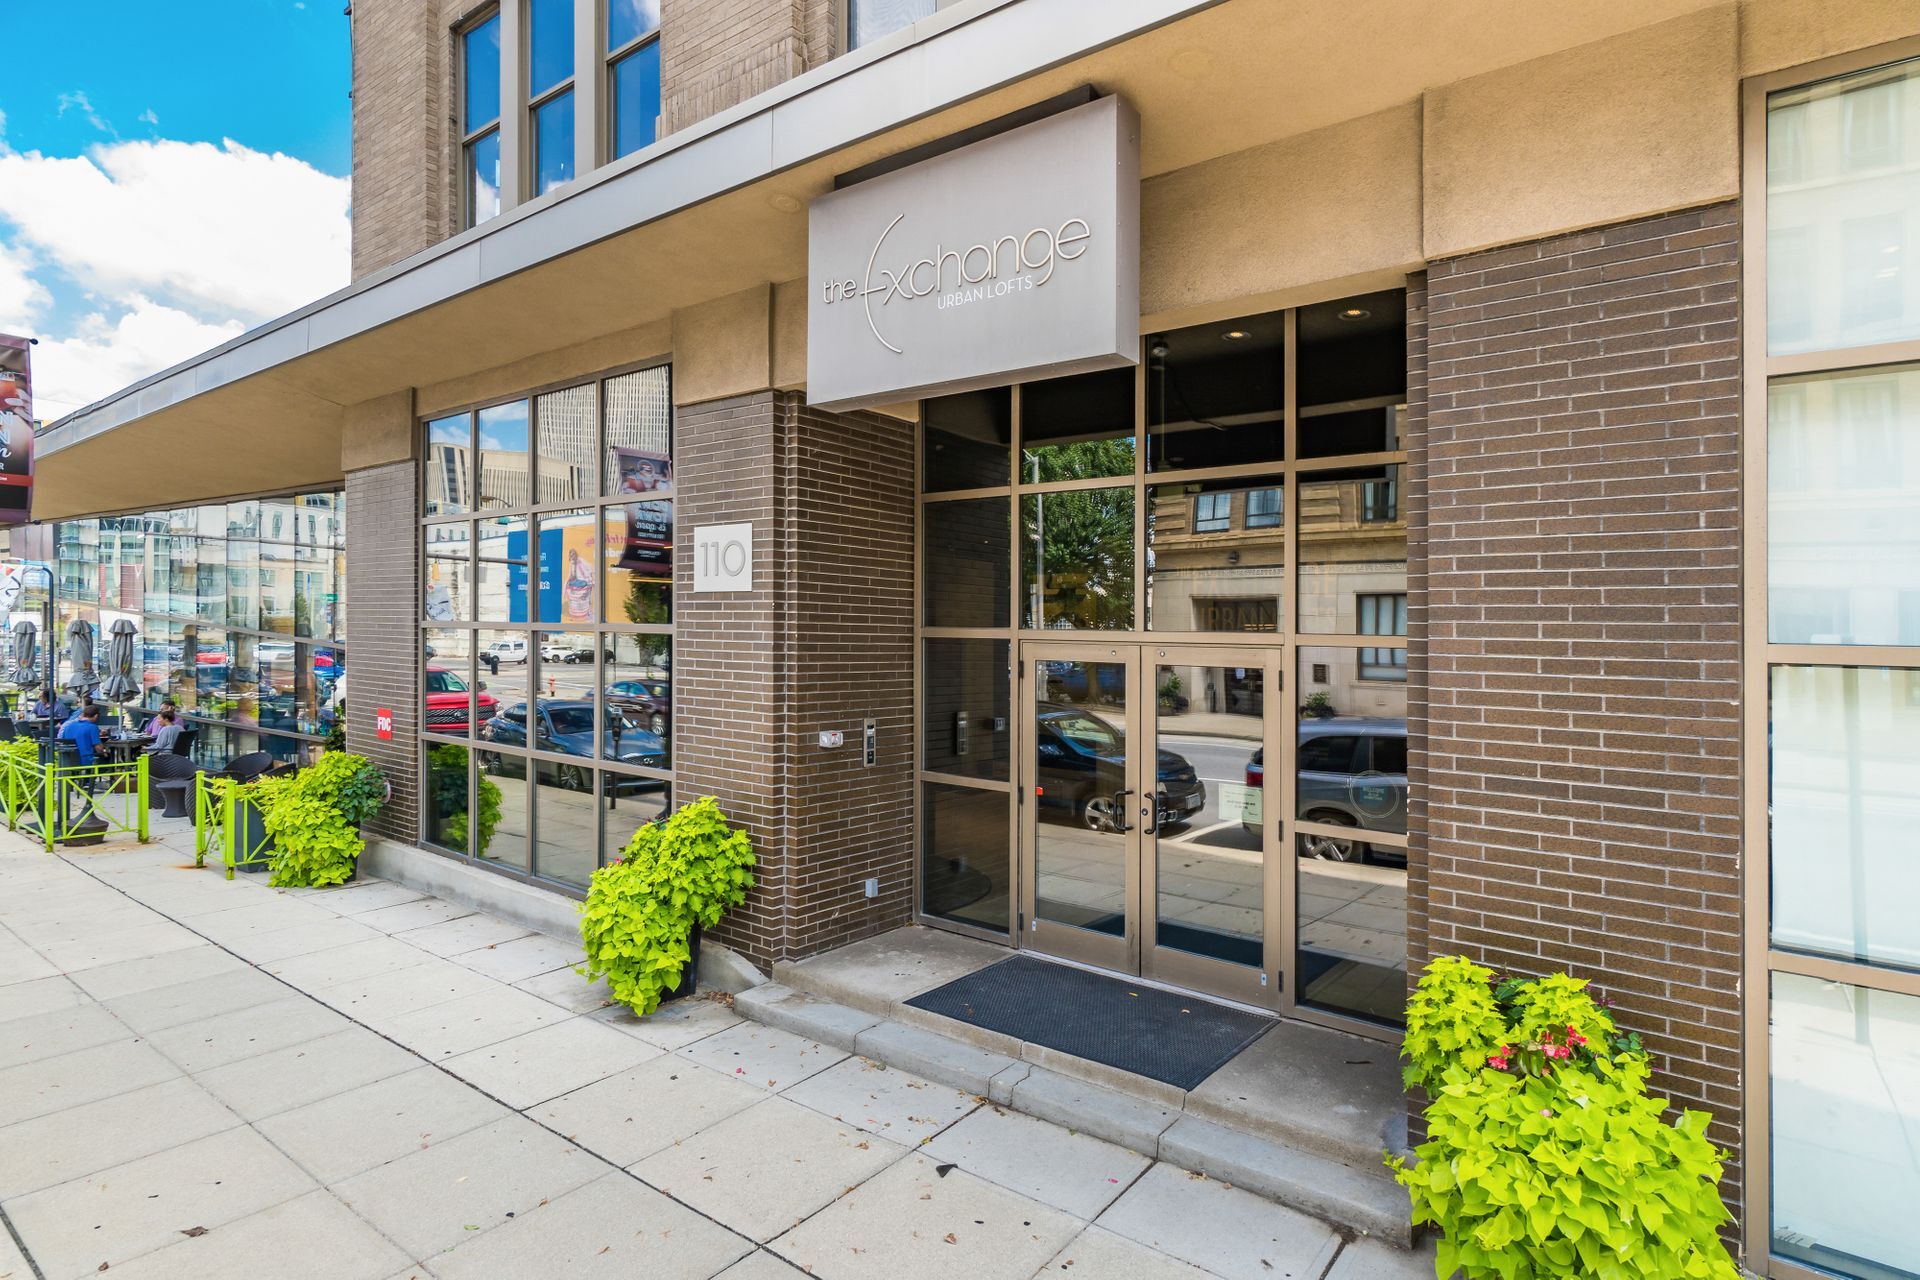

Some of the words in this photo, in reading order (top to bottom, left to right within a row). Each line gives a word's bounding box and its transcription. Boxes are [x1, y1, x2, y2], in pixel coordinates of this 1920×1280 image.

[823, 279, 857, 304] the
[860, 213, 1091, 354] Exchange
[937, 287, 983, 309] URBAN
[987, 275, 1033, 298] LOFTS
[699, 540, 747, 577] 110
[377, 716, 392, 731] FDC
